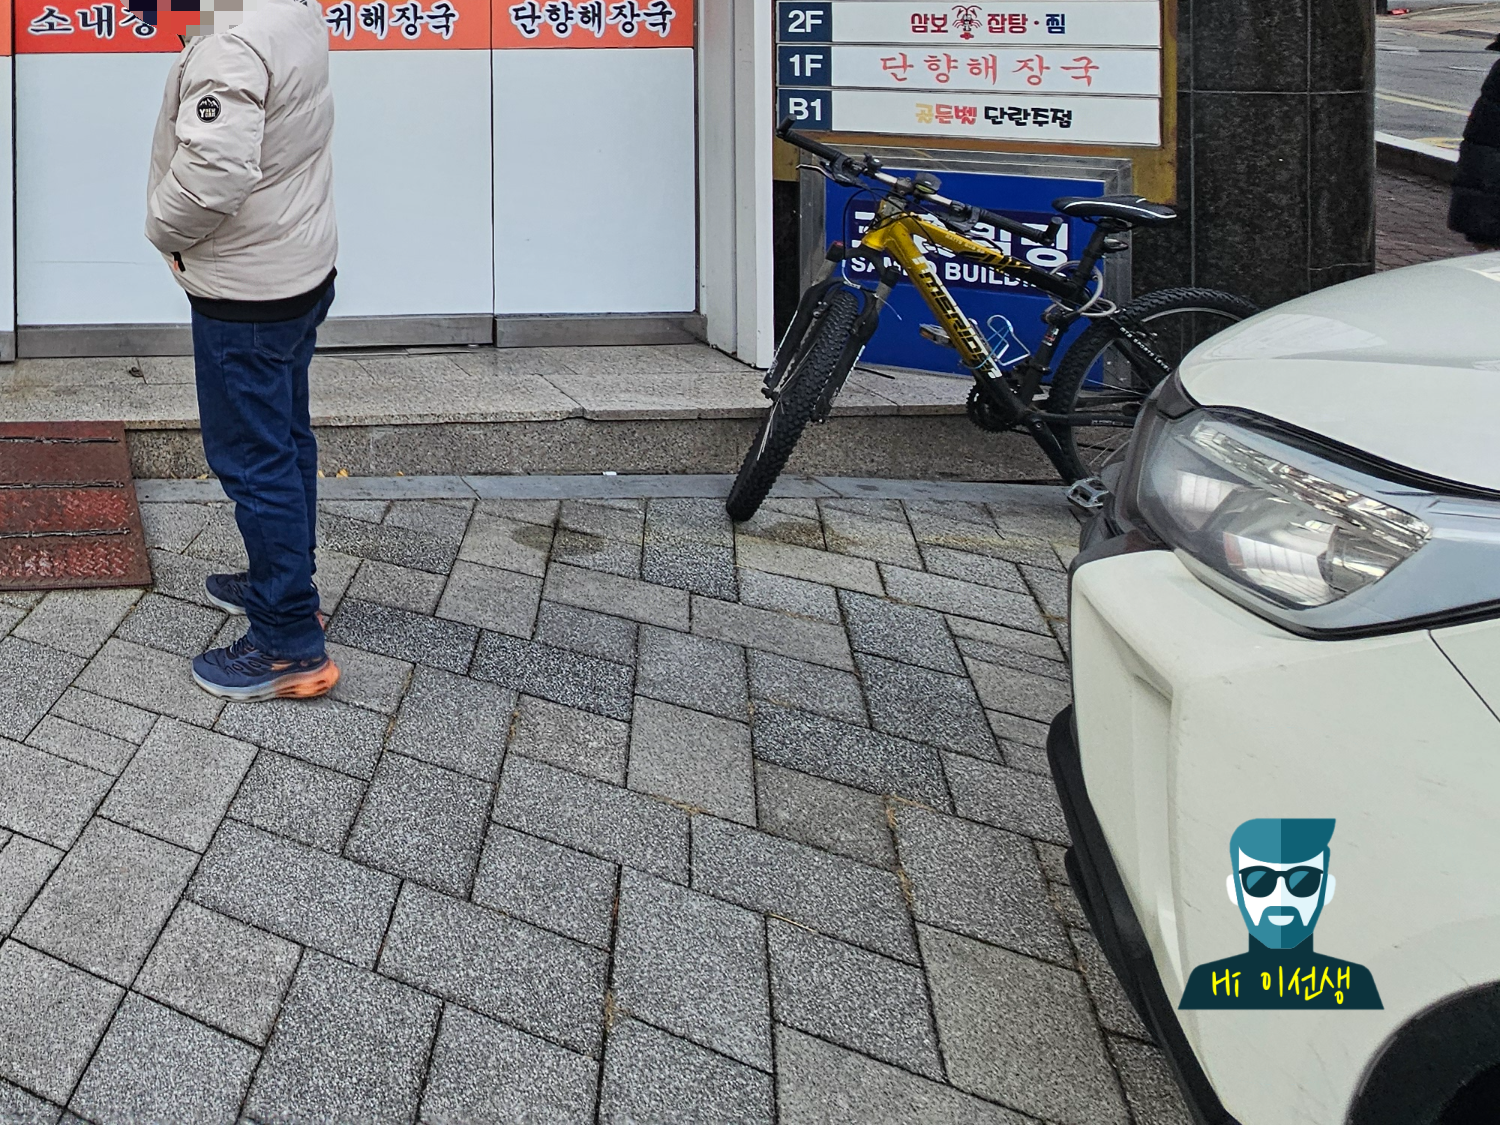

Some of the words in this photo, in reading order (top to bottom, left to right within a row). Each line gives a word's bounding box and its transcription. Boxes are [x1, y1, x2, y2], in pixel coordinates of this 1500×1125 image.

[787, 10, 824, 33] 2F
[911, 13, 949, 34] 삼보
[789, 53, 824, 76] 1F
[880, 53, 1100, 87] 단향해장국
[788, 97, 823, 121] B1
[984, 106, 1073, 129] 단란주점
